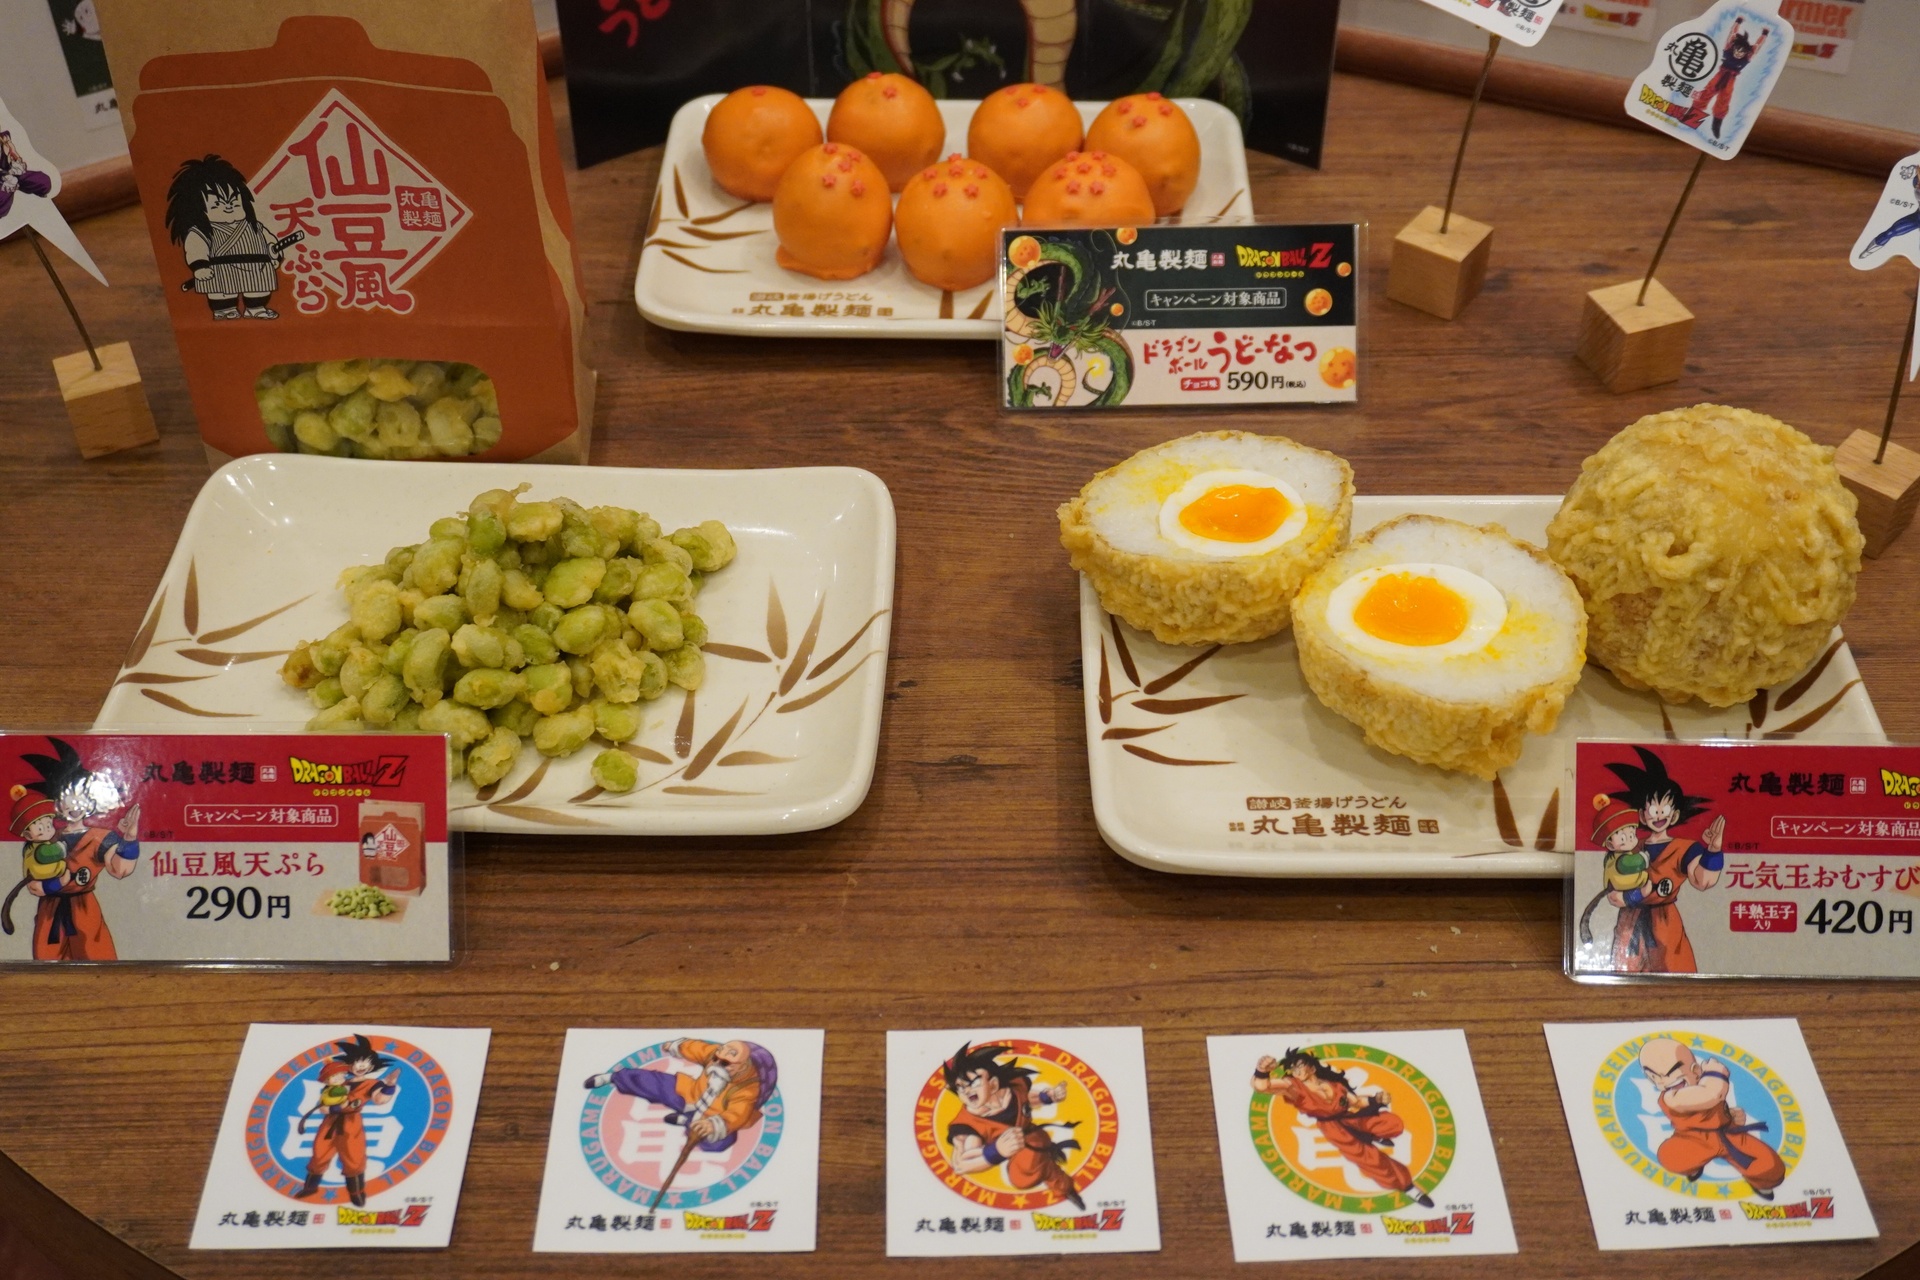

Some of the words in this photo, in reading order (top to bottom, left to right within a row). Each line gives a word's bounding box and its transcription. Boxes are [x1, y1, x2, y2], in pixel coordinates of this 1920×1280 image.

[1675, 37, 1708, 79] 亀
[1661, 74, 1695, 98] 製麺
[400, 190, 440, 209] 丸亀
[287, 120, 413, 312] 仙豆風
[402, 210, 442, 228] 製麺
[269, 197, 326, 312] 天ぷら
[1110, 249, 1208, 271] 丸亀製麺
[1308, 243, 1335, 268] Z
[749, 303, 872, 317] 丸亀製麺
[1150, 291, 1281, 307] キャンペーン対象商品
[1143, 336, 1201, 364] ドラゴン
[1207, 331, 1317, 373] うどーなつ
[1168, 356, 1208, 375] ボール
[1183, 380, 1219, 389] チョコ味
[143, 760, 255, 785] 丸亀製麺
[374, 755, 409, 787] Z
[1879, 768, 1920, 798] DRAG
[1728, 771, 1846, 797] 丸亀製麺
[1293, 796, 1407, 809] 釜揚げうどん
[189, 807, 333, 824] キャンペーン対象商品
[1250, 813, 1412, 837] 丸亀製麺
[1776, 820, 1920, 838] キャンペーン対象商品
[149, 850, 325, 878] 仙豆風天ぷら
[1725, 861, 1920, 892] 元気玉おむすび
[1732, 904, 1795, 920] 半熟玉子
[1753, 920, 1771, 930] 入り
[407, 1049, 450, 1131] DRAGON
[1055, 1051, 1117, 1134] DRAGON
[1382, 1054, 1455, 1136] DRAGON
[1719, 1043, 1802, 1123] DRAGON
[580, 1093, 652, 1205] MARUGAME
[915, 1096, 998, 1207] MARUGAME
[1595, 1089, 1699, 1197] MARUGAME
[379, 1139, 437, 1186] BALL
[719, 1142, 775, 1192] BALL
[1251, 1101, 1343, 1210] MARUGAME
[218, 1210, 310, 1228] 丸亀製麺
[400, 1205, 431, 1226] Z
[1098, 1209, 1126, 1230] Z
[1625, 1207, 1717, 1225] 丸亀製麺
[1809, 1197, 1834, 1219] Z
[565, 1214, 655, 1232] 丸亀製麺
[749, 1210, 778, 1231] Z
[914, 1217, 1005, 1234] 丸亀製麺
[1265, 1221, 1357, 1238] 丸亀製麺
[1449, 1212, 1475, 1234] Z
